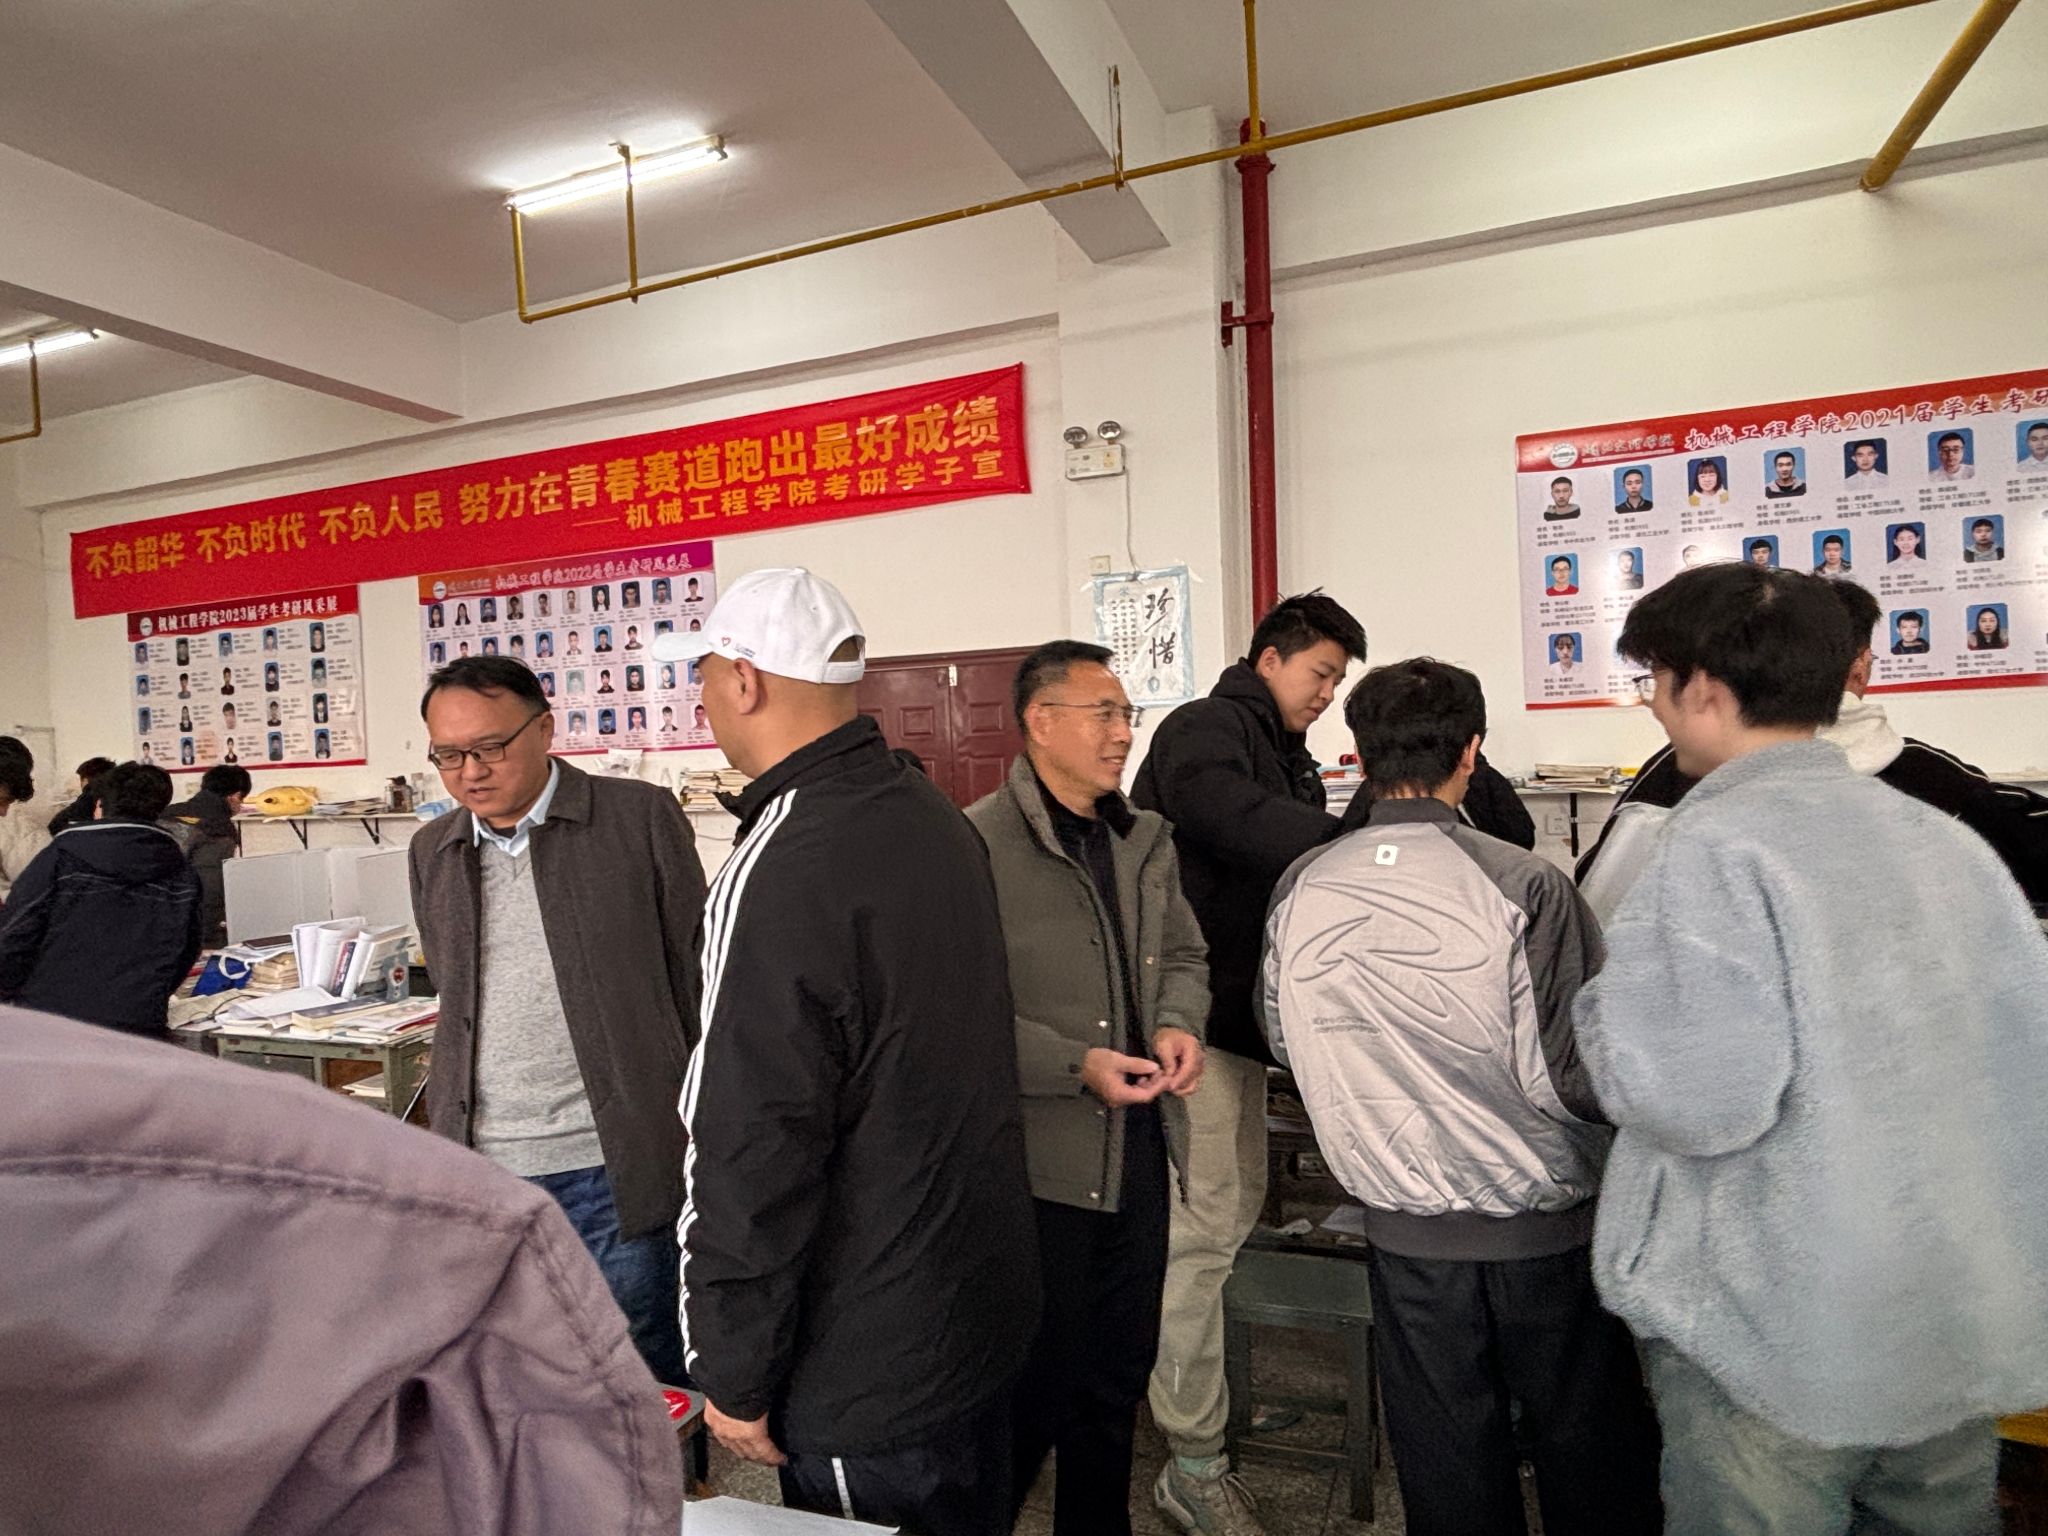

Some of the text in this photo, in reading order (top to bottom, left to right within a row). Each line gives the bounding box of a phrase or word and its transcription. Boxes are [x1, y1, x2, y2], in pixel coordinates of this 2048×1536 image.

[84, 395, 1000, 580] 不负韶华 不负时代 不负人民 努力在青春赛道跑出最好成绩
[1143, 586, 1176, 669] 珍惜
